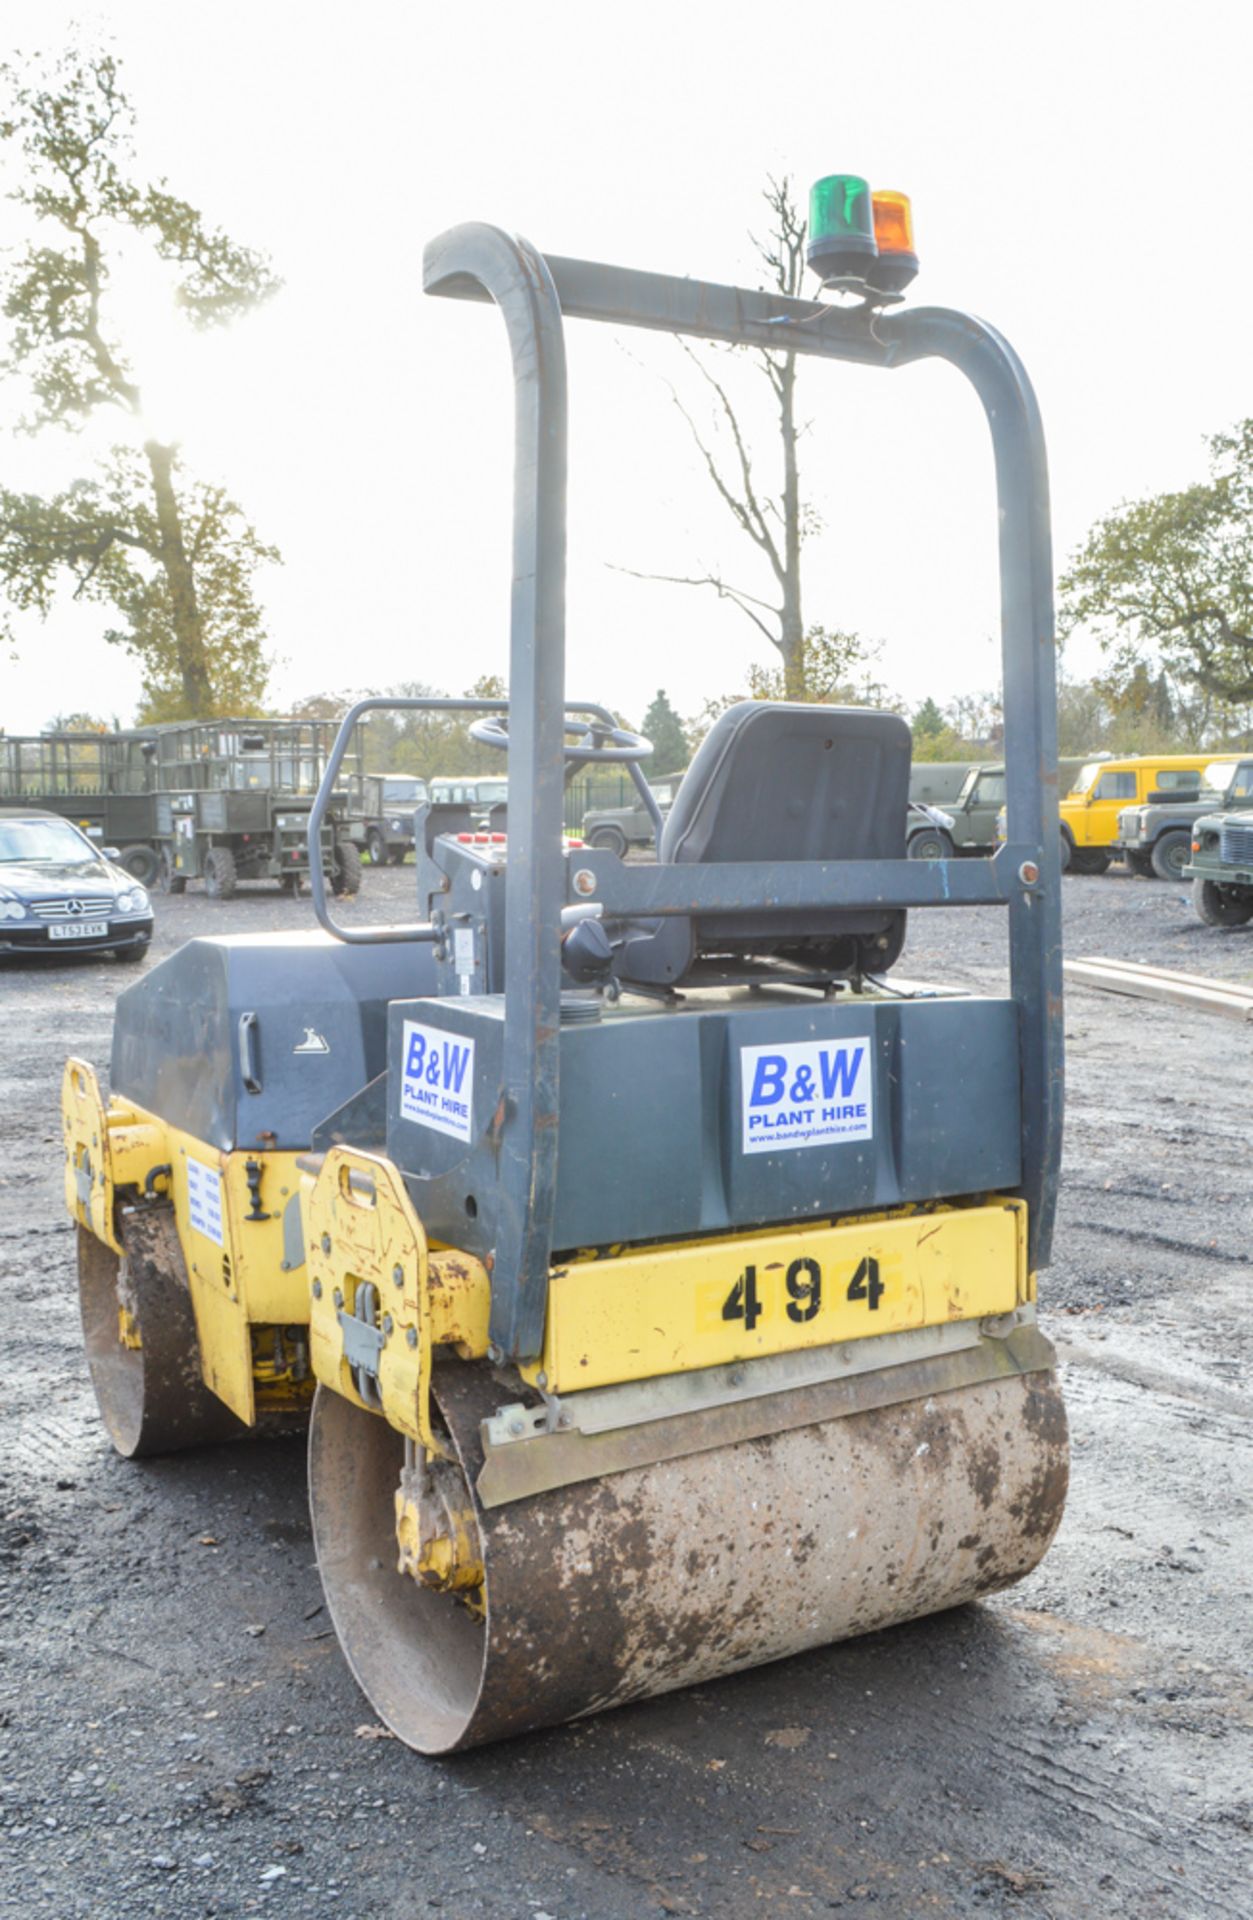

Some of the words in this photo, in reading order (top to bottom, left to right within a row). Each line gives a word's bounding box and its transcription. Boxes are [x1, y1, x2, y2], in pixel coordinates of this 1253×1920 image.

[405, 1031, 471, 1094] B&W
[749, 1047, 865, 1107] B&W
[404, 1083, 438, 1107] PLANT
[441, 1097, 468, 1119] HIRE
[749, 1109, 815, 1130] PLANT
[822, 1103, 867, 1122] HIRE
[749, 1123, 867, 1143] www.bandwplanthire.com
[722, 1256, 885, 1331] 494
